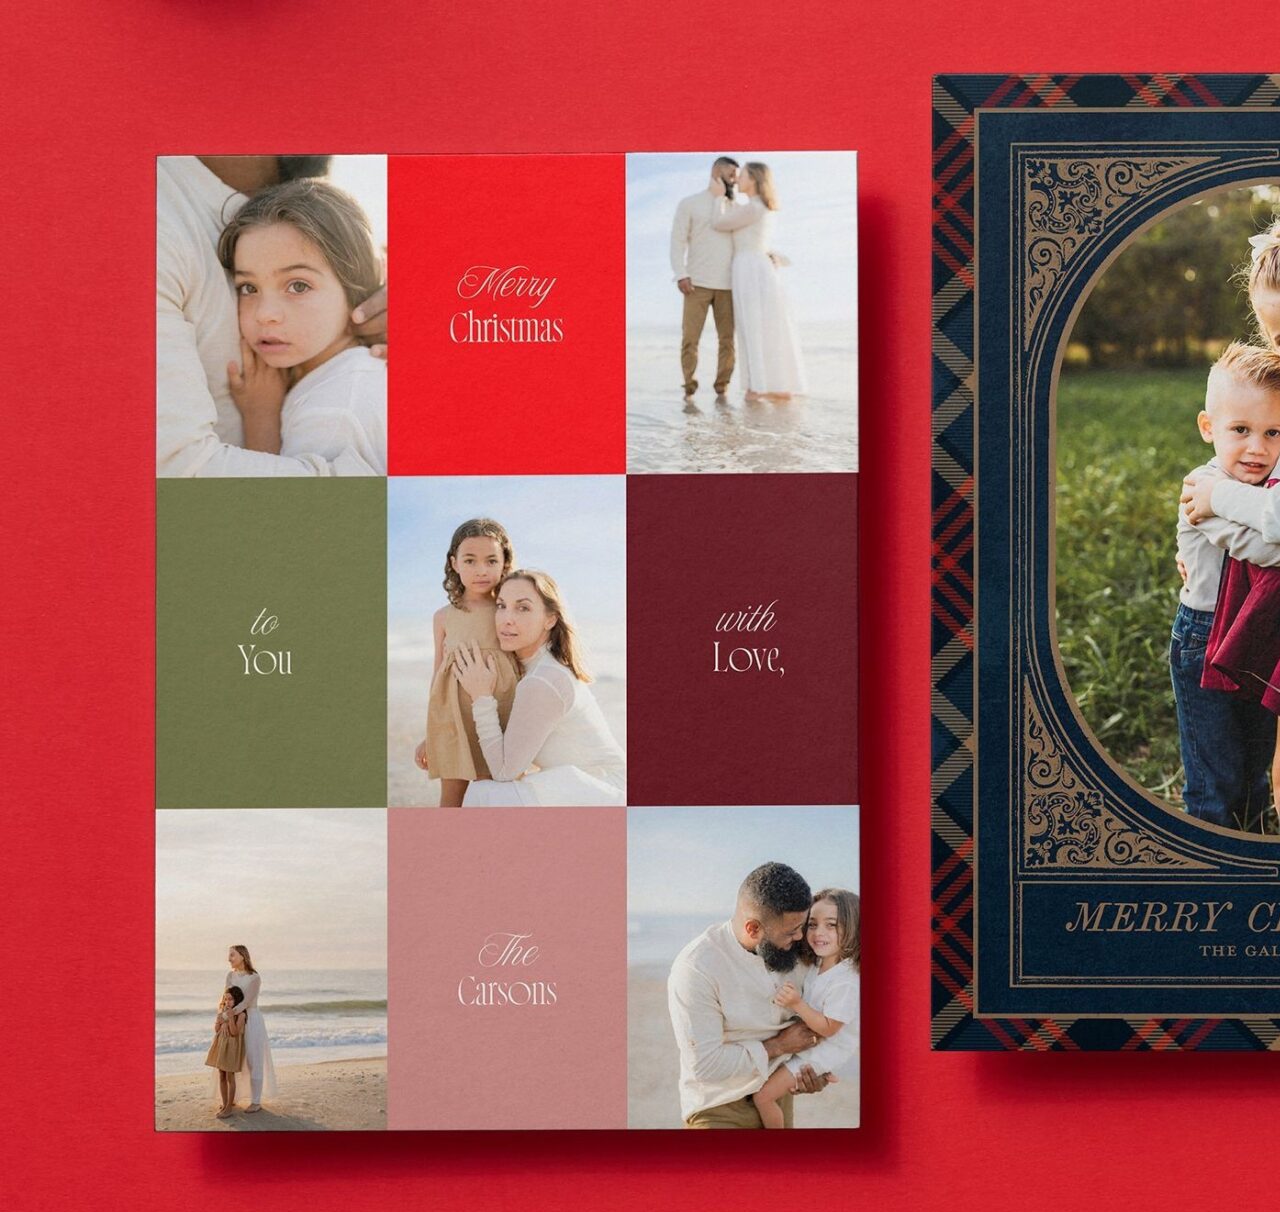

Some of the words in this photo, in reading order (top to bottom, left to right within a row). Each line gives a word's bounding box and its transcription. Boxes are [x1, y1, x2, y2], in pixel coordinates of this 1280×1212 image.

[457, 265, 558, 309] Merry
[450, 309, 564, 344] Christmas
[250, 607, 281, 636] to
[715, 599, 780, 633] with
[237, 643, 293, 676] You
[713, 640, 786, 679] Love,
[1064, 900, 1234, 933] MERRY
[478, 931, 541, 968] The
[1199, 944, 1238, 957] THE
[457, 975, 559, 1006] Carsons
